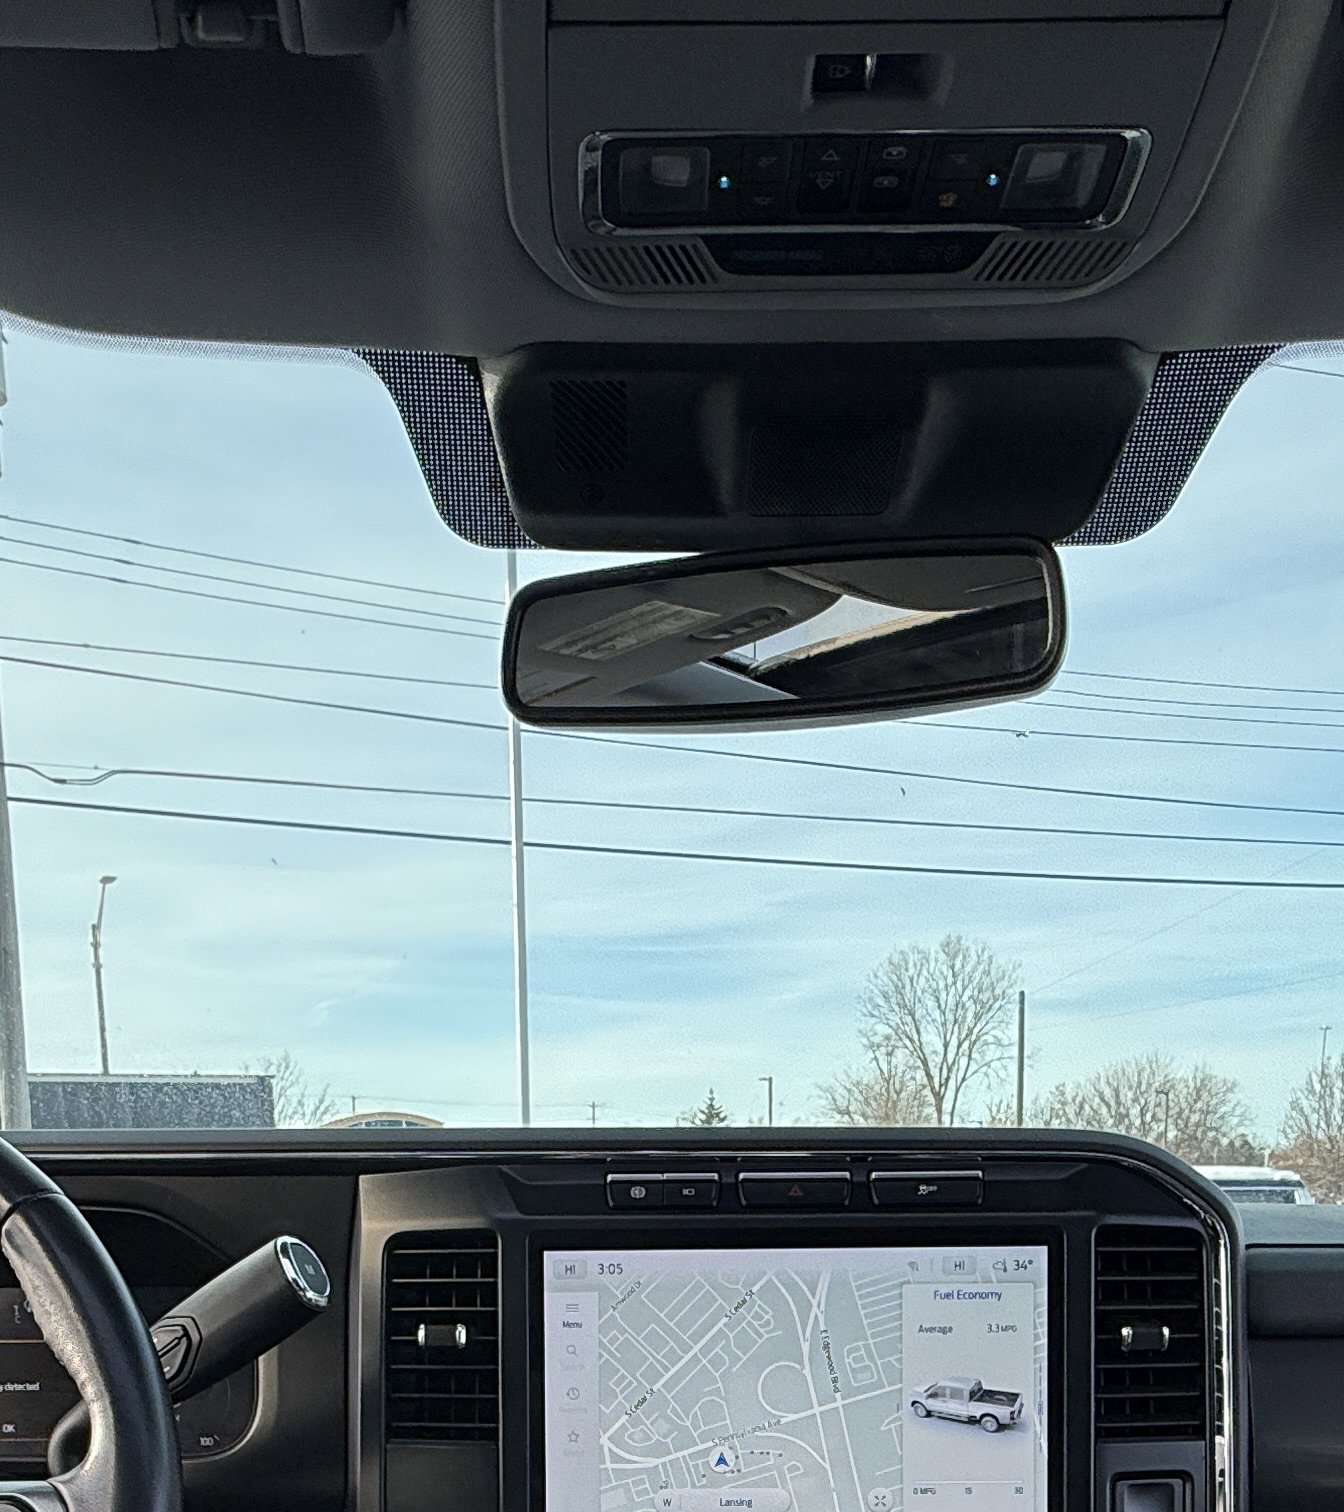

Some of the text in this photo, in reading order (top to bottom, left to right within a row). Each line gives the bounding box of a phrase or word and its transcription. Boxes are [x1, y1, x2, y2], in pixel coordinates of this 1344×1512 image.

[597, 1263, 624, 1275] 3:05
[933, 1289, 1003, 1302] Fuel Economy
[729, 1296, 749, 1316] Cedar
[745, 1289, 756, 1300] St
[562, 1320, 583, 1329] Menu
[917, 1324, 954, 1336] Average
[5, 1382, 40, 1391] detected
[830, 1376, 842, 1394] Blvd
[629, 1395, 648, 1414] Cedar
[646, 1387, 657, 1398] St
[2, 1423, 16, 1433] OK
[767, 1418, 783, 1429] Ave
[199, 1437, 214, 1446] 100
[662, 1498, 673, 1507] W
[719, 1497, 753, 1509] Lansing
